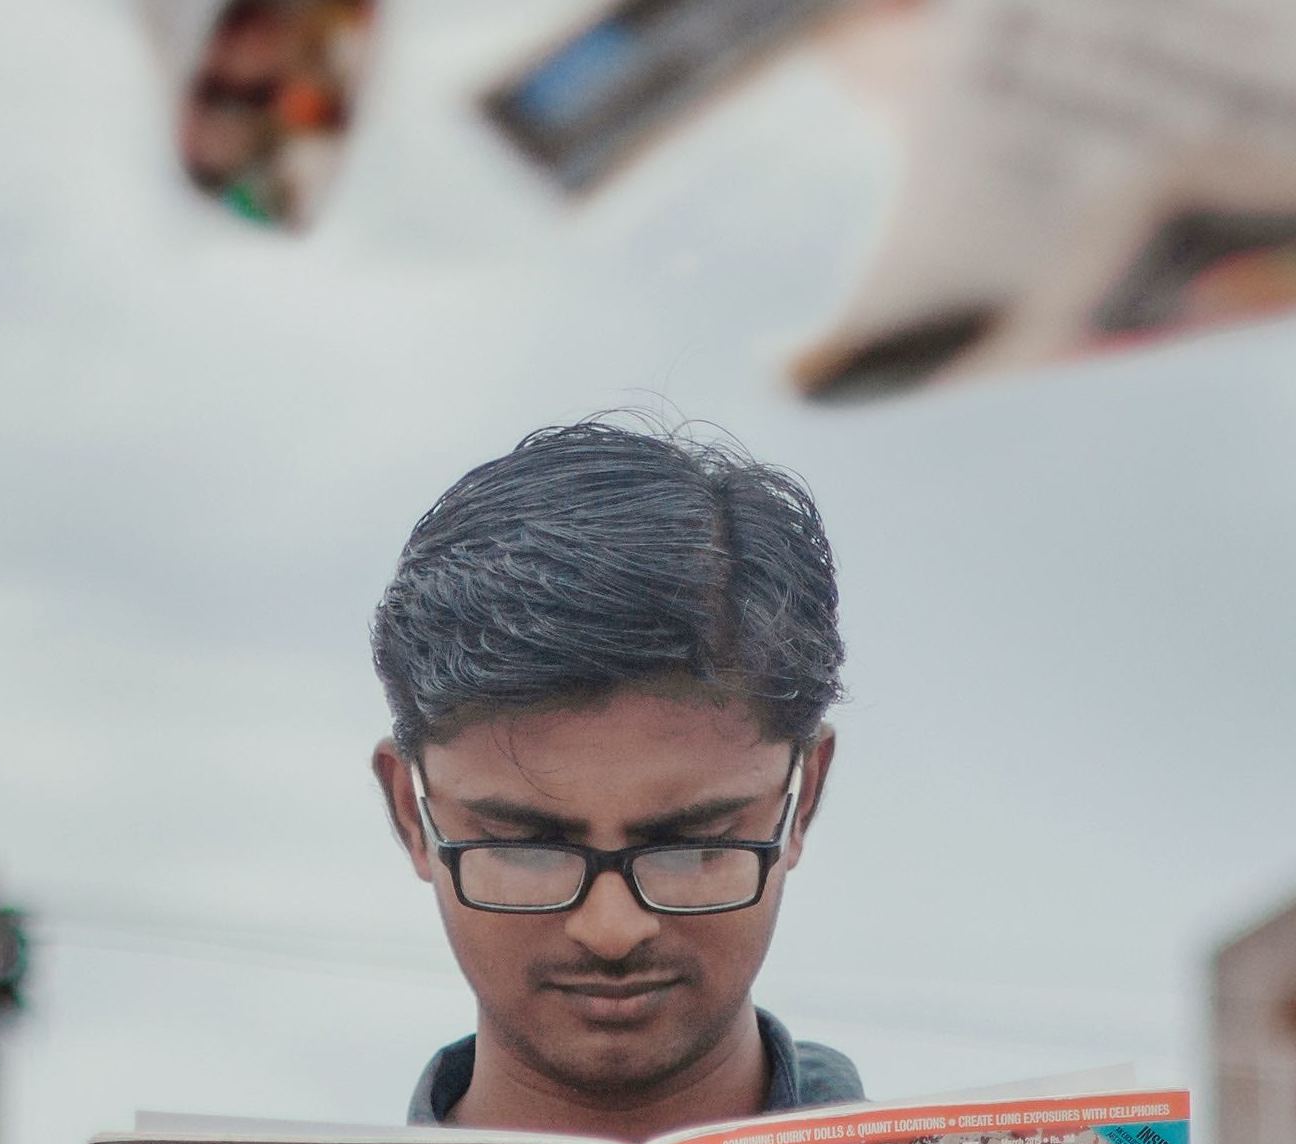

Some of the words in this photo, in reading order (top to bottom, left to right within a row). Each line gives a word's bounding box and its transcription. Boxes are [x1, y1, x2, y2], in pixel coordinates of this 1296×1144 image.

[814, 1125, 844, 1141] DOLLS
[846, 1125, 856, 1137] &
[857, 1121, 891, 1138] QUAINT
[894, 1116, 947, 1133] LOCATIONS
[958, 1115, 993, 1129] CREATE
[995, 1113, 1022, 1126] LONG
[1023, 1109, 1081, 1124] EXPOSURES
[1082, 1107, 1107, 1120] WITH
[1109, 1103, 1171, 1118] CELLPHONES
